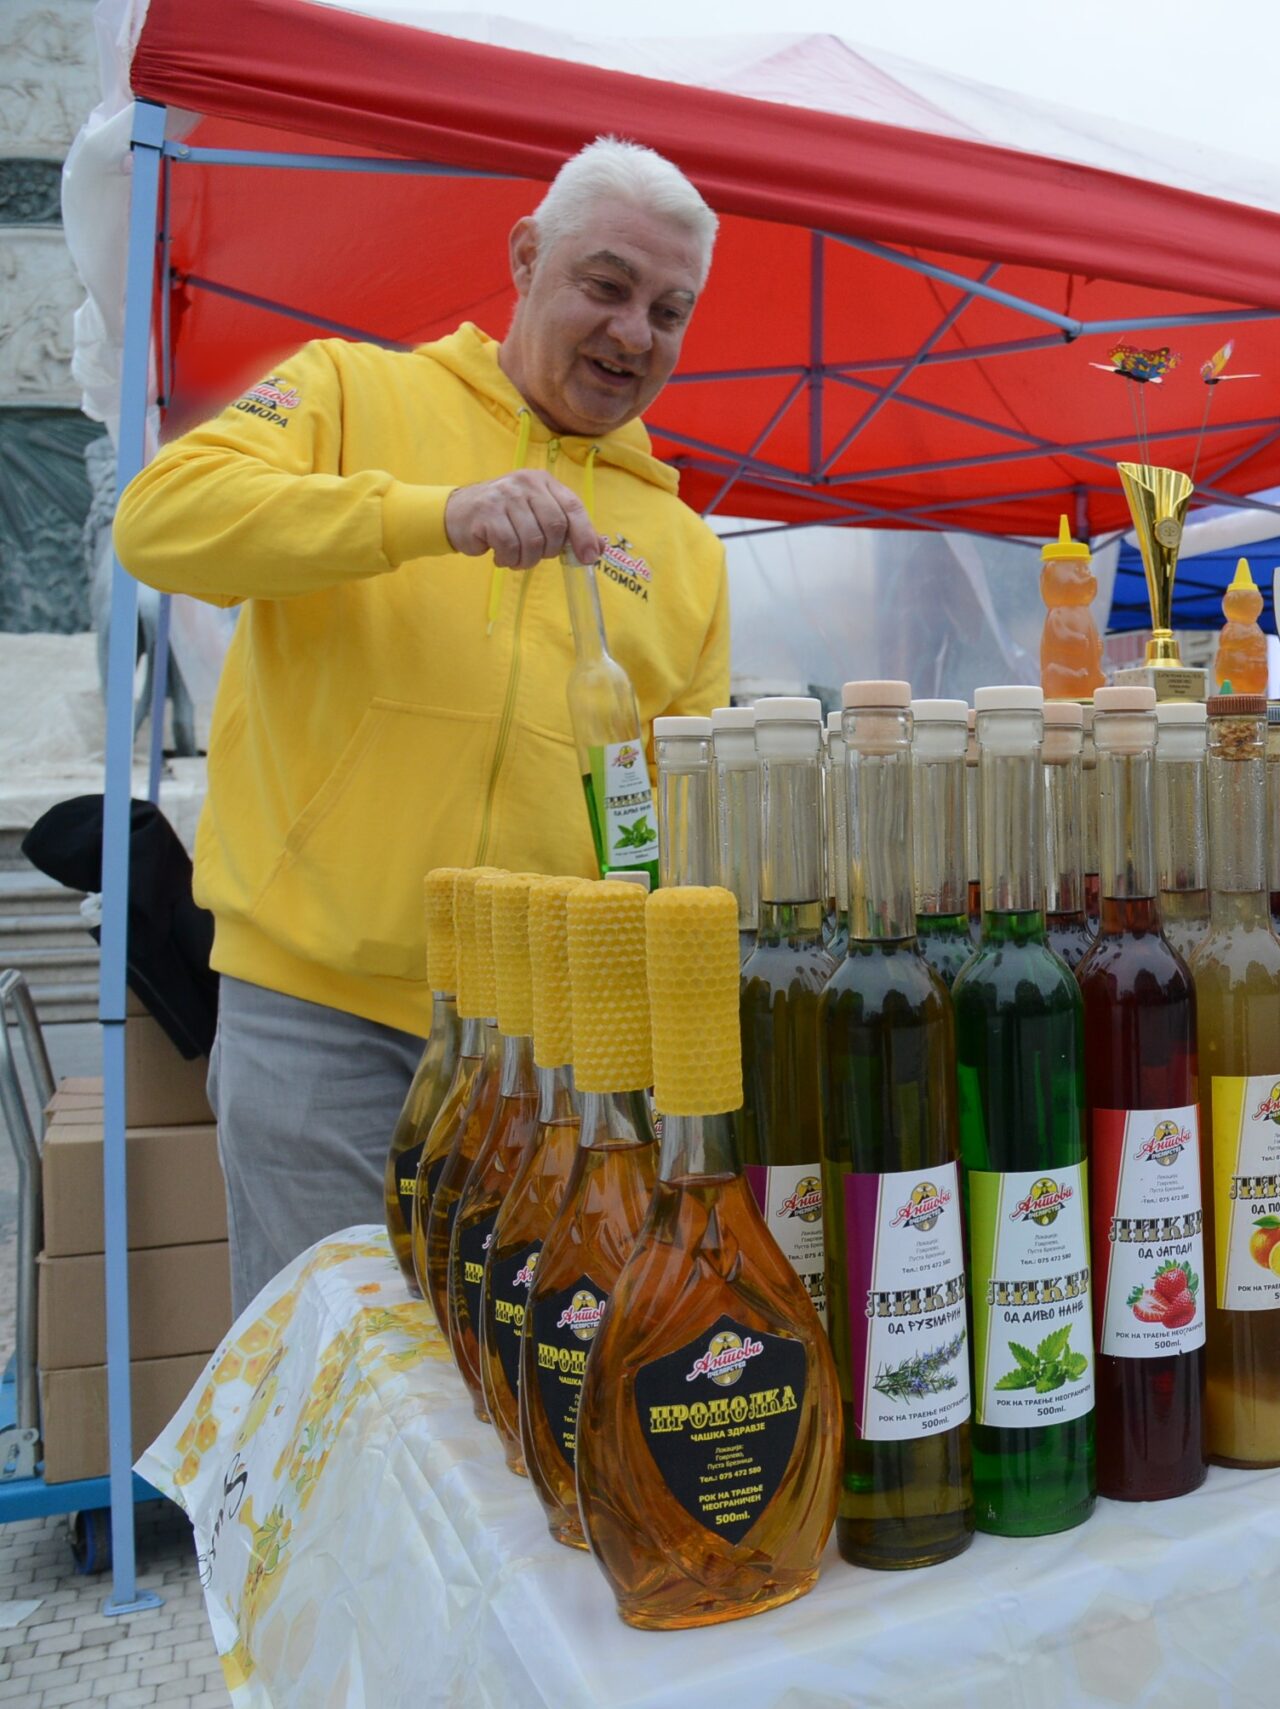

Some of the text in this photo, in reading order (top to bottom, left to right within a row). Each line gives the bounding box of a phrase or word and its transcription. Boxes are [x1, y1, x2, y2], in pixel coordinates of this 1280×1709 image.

[234, 401, 289, 428] ОМОРА
[776, 1192, 822, 1217] Ант
[1251, 1204, 1266, 1215] ОД
[1138, 1242, 1192, 1259] ОД ЈАГОДИ
[988, 1268, 1089, 1306] ЛИКЕР
[888, 1307, 961, 1334] ОД РУЗМАРИН
[1004, 1300, 1084, 1323] ОД ДИВО НАНЕ
[538, 1343, 586, 1375] ПРОП
[559, 1376, 583, 1386] ЧАШКА
[649, 1385, 798, 1433] ПРОПОЛКА
[1025, 1397, 1053, 1406] ТРАЕЊЕ
[909, 1408, 937, 1420] ТРАЕЊЕ
[690, 1422, 766, 1442] ЧАШКА ЗДРАВЈЕ
[719, 1471, 733, 1480] 075
[734, 1469, 747, 1477] 472
[748, 1466, 762, 1475] 580
[699, 1484, 764, 1503] РОК НА ТРАЕЊЕ
[702, 1494, 762, 1511] НЕОГРАНИЧЕН
[715, 1510, 751, 1525] 500ml.
